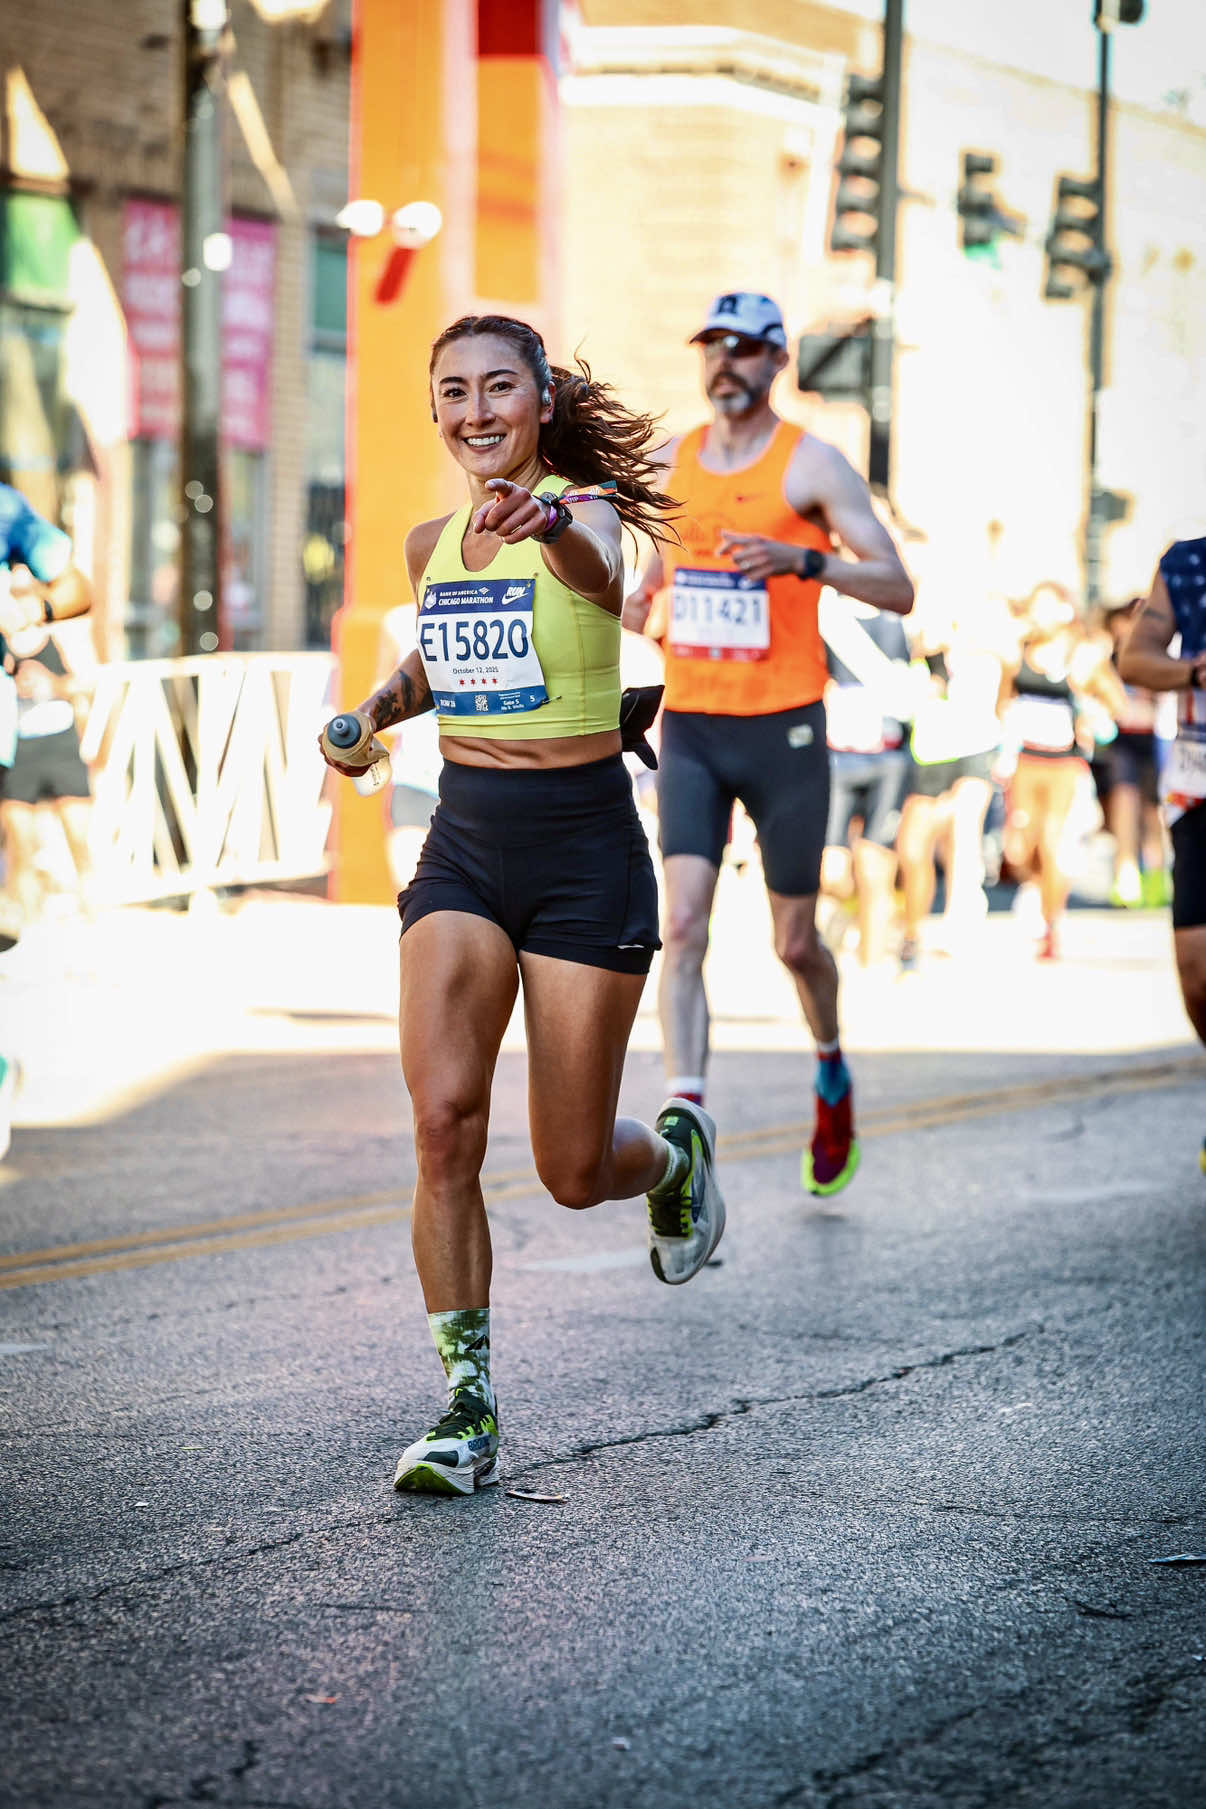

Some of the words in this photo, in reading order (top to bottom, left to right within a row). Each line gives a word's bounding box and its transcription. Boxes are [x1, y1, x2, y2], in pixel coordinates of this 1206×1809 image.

[507, 587, 526, 596] RUN
[438, 598, 460, 606] CHICAGO
[461, 596, 494, 605] MARATHON
[420, 619, 529, 662] E15820
[452, 667, 475, 675] October
[475, 667, 485, 675] 12,
